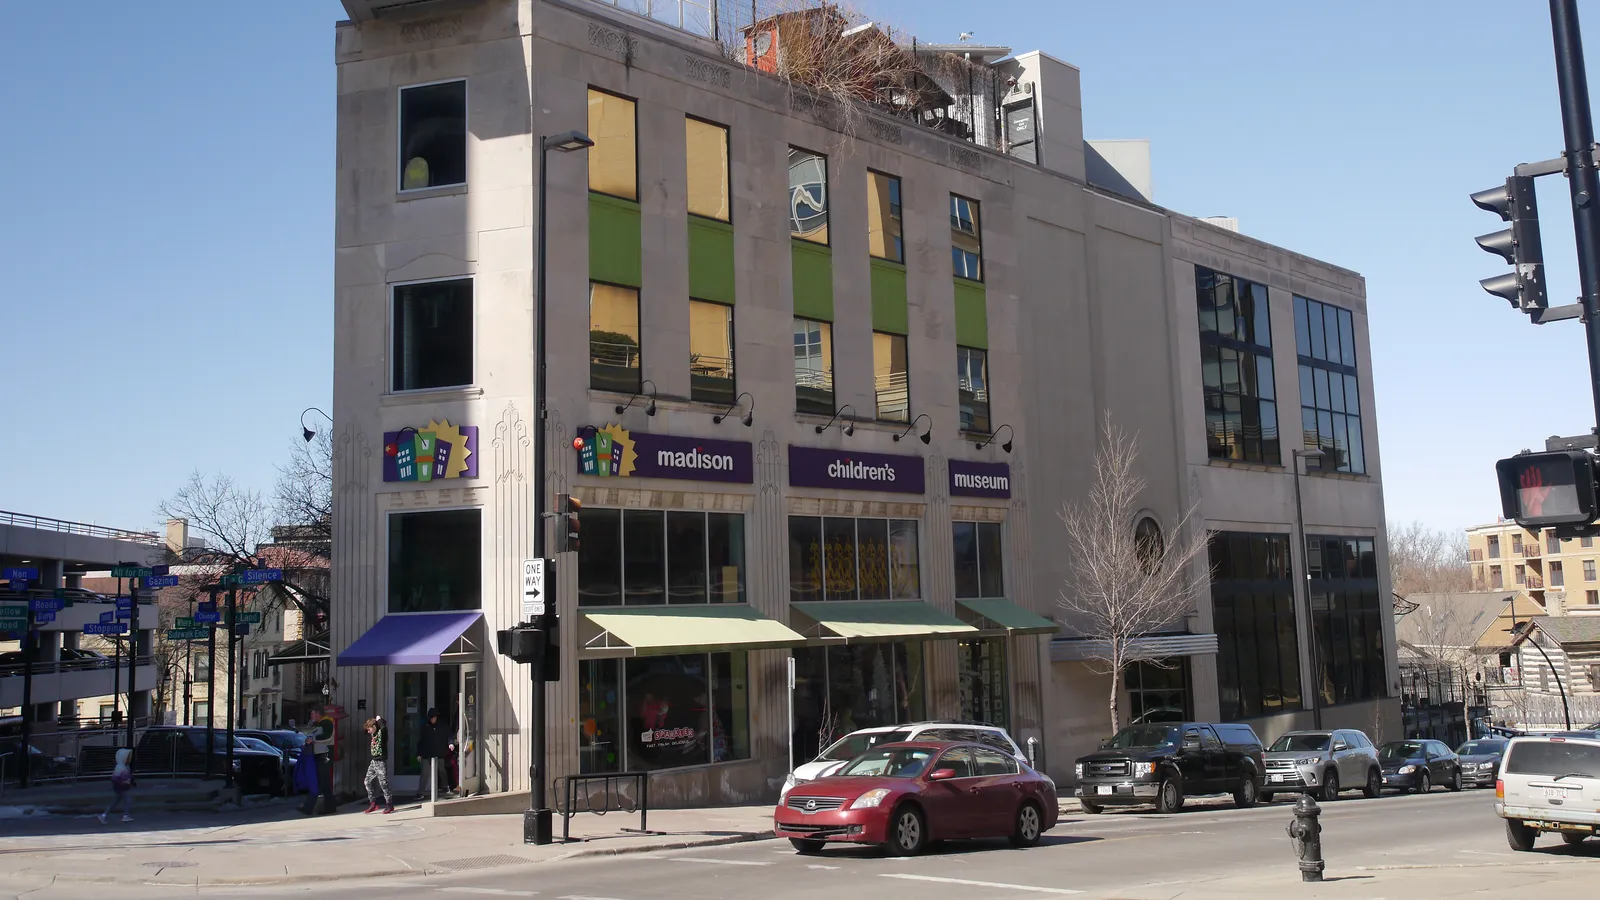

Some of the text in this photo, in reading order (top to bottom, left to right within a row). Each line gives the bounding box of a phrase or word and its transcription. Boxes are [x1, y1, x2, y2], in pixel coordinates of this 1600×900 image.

[657, 446, 734, 472] madison
[827, 457, 896, 482] children's
[954, 472, 1009, 491] museum
[12, 569, 28, 578] Non
[113, 568, 152, 577] All for One
[525, 563, 541, 575] ONE
[247, 571, 278, 580] Silence
[148, 577, 174, 586] Gazing
[525, 576, 541, 586] WAY
[35, 600, 58, 609] Roads
[240, 613, 258, 622] Land
[88, 624, 123, 634] Stopping
[168, 629, 209, 640] Sidewalk Ends
